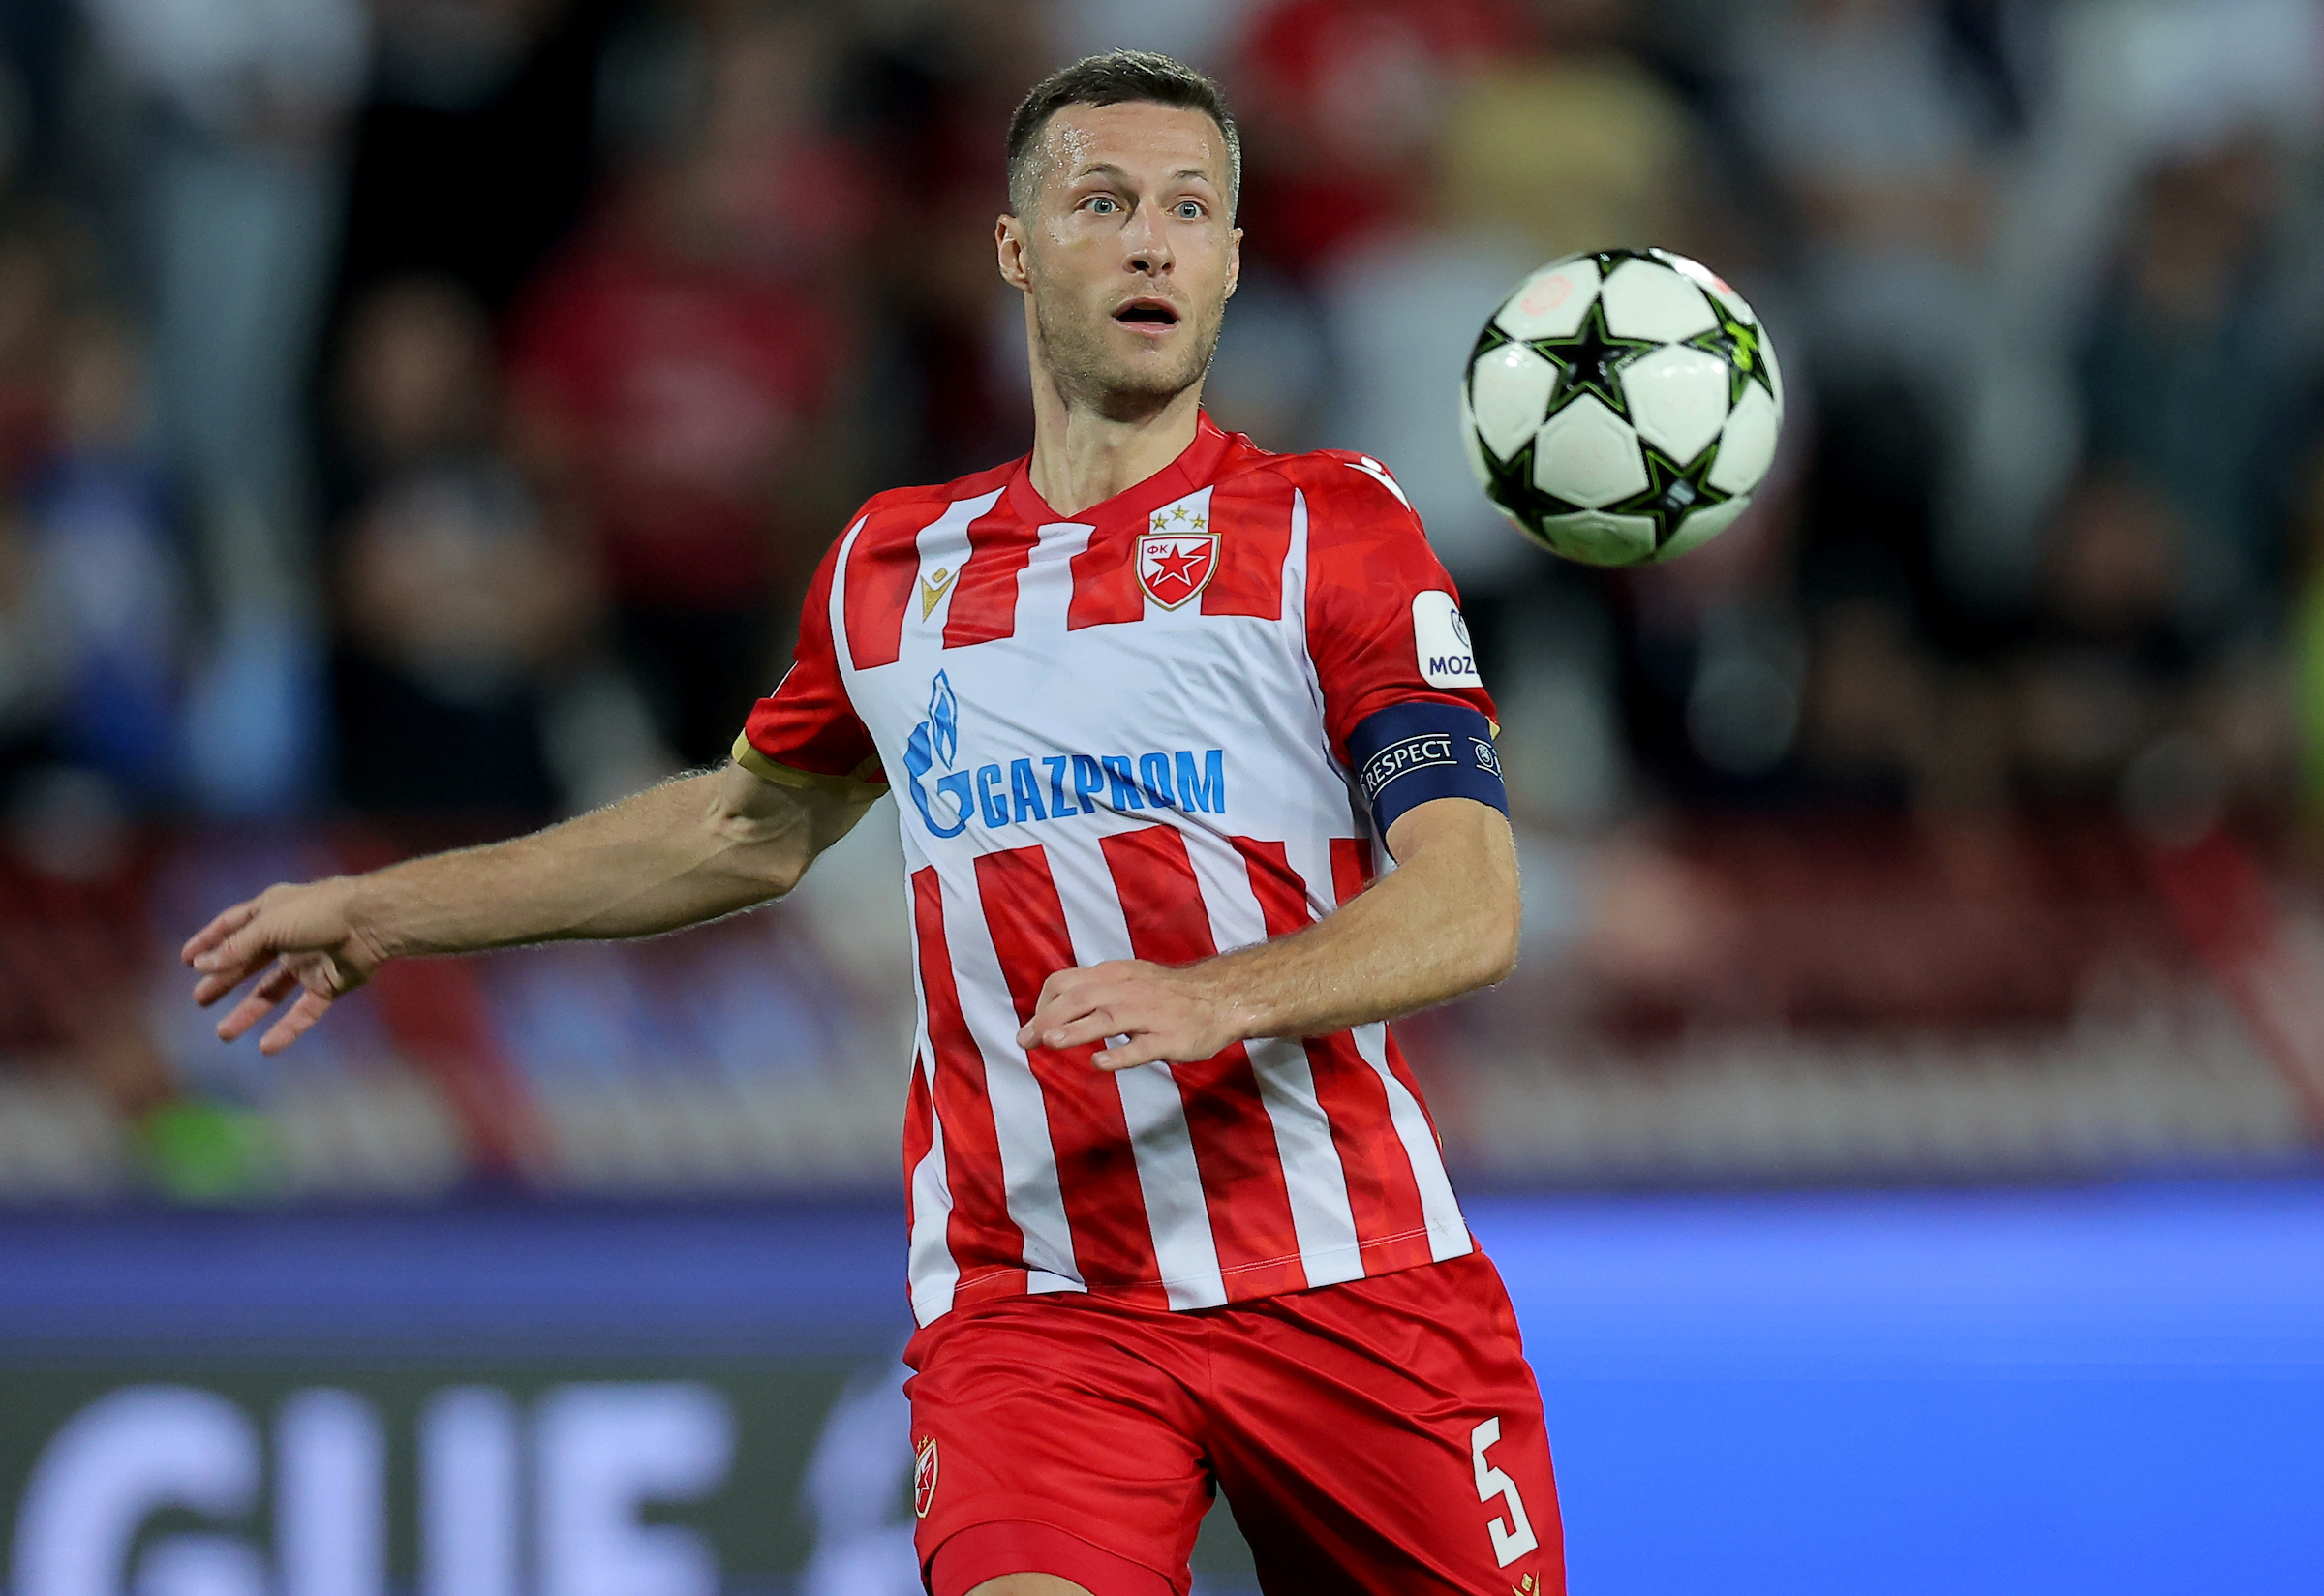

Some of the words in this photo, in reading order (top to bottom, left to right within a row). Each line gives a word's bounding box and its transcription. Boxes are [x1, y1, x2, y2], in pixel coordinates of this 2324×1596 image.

[1430, 656, 1478, 675] MOZ
[977, 750, 1225, 828] GAZPROM
[1365, 740, 1452, 792] RESPECT
[1471, 1416, 1538, 1569] 5
